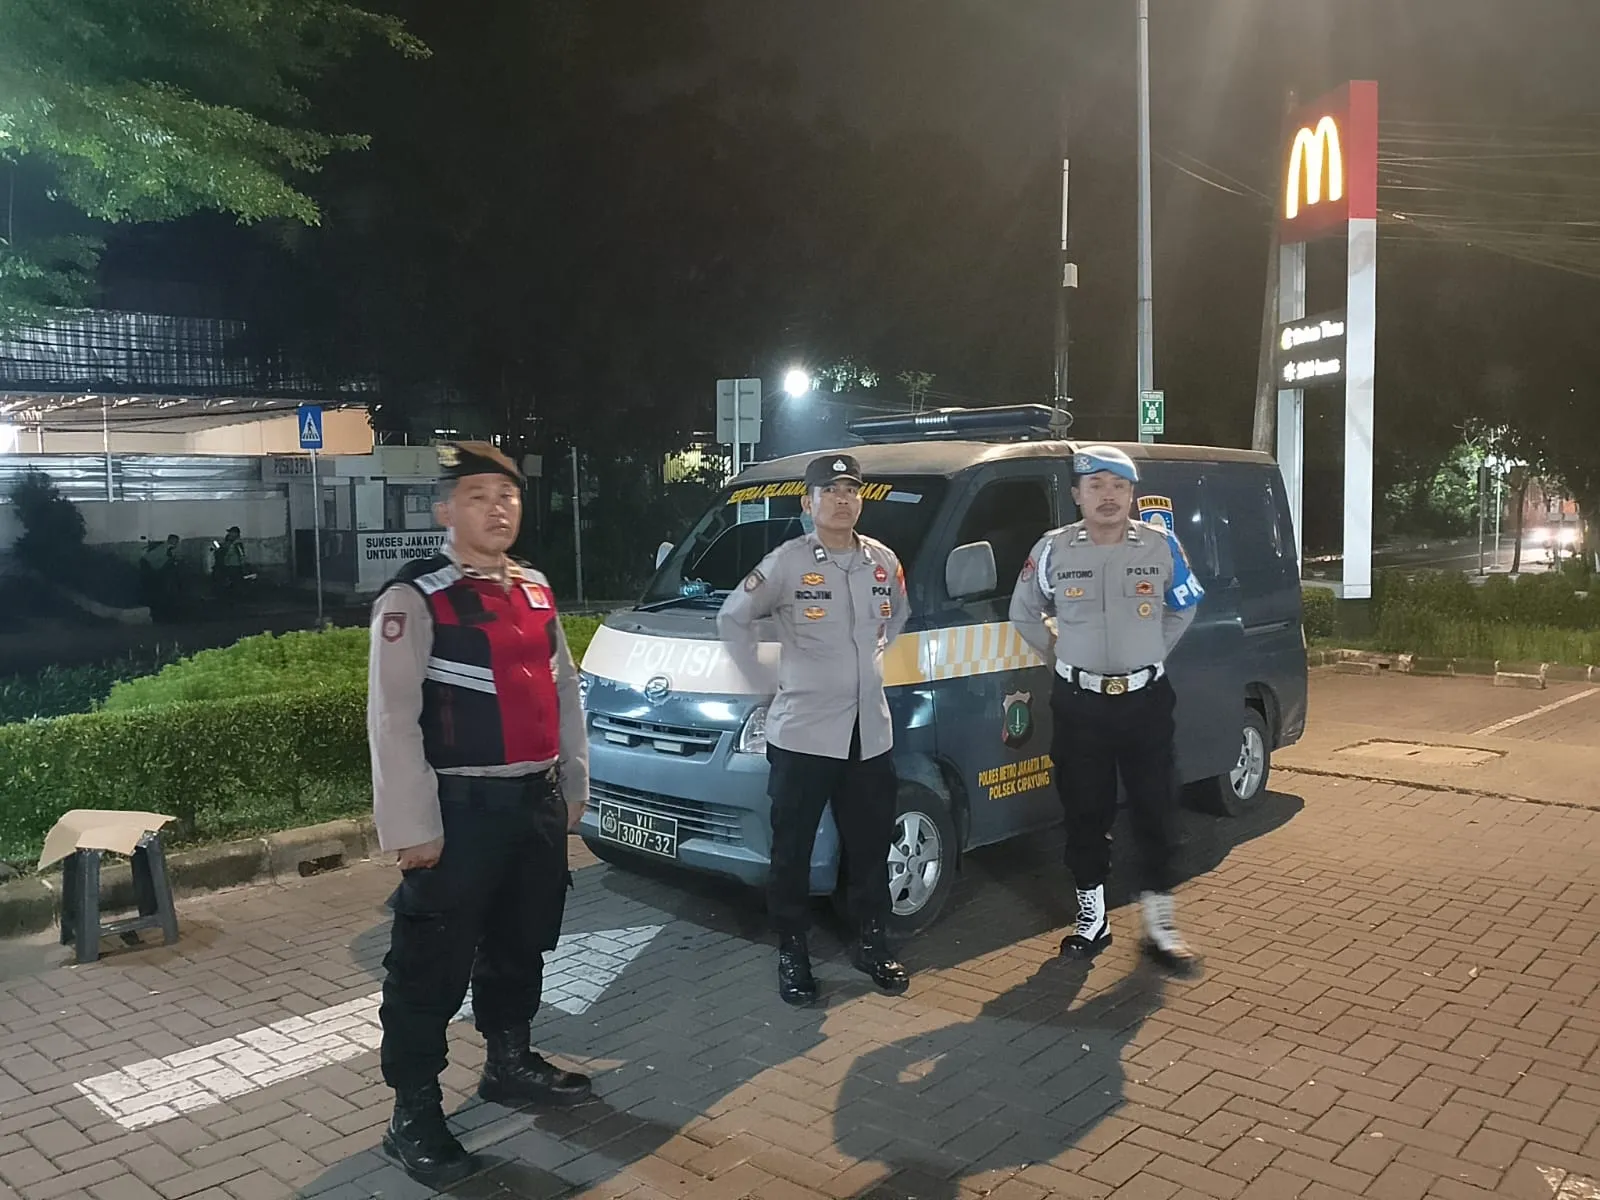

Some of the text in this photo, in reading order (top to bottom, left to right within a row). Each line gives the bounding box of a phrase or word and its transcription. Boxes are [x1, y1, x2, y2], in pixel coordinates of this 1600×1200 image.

[757, 480, 808, 499] PELAYANA
[366, 537, 403, 548] SUKSES
[366, 547, 442, 560] UNTUK INDONES
[1126, 567, 1160, 576] POLRI
[625, 639, 721, 679] POLISI
[978, 767, 999, 788] POLRES
[989, 770, 1050, 800] POLSEK CIPAYUNG
[636, 813, 653, 830] VII
[621, 825, 670, 853] 3007-32
